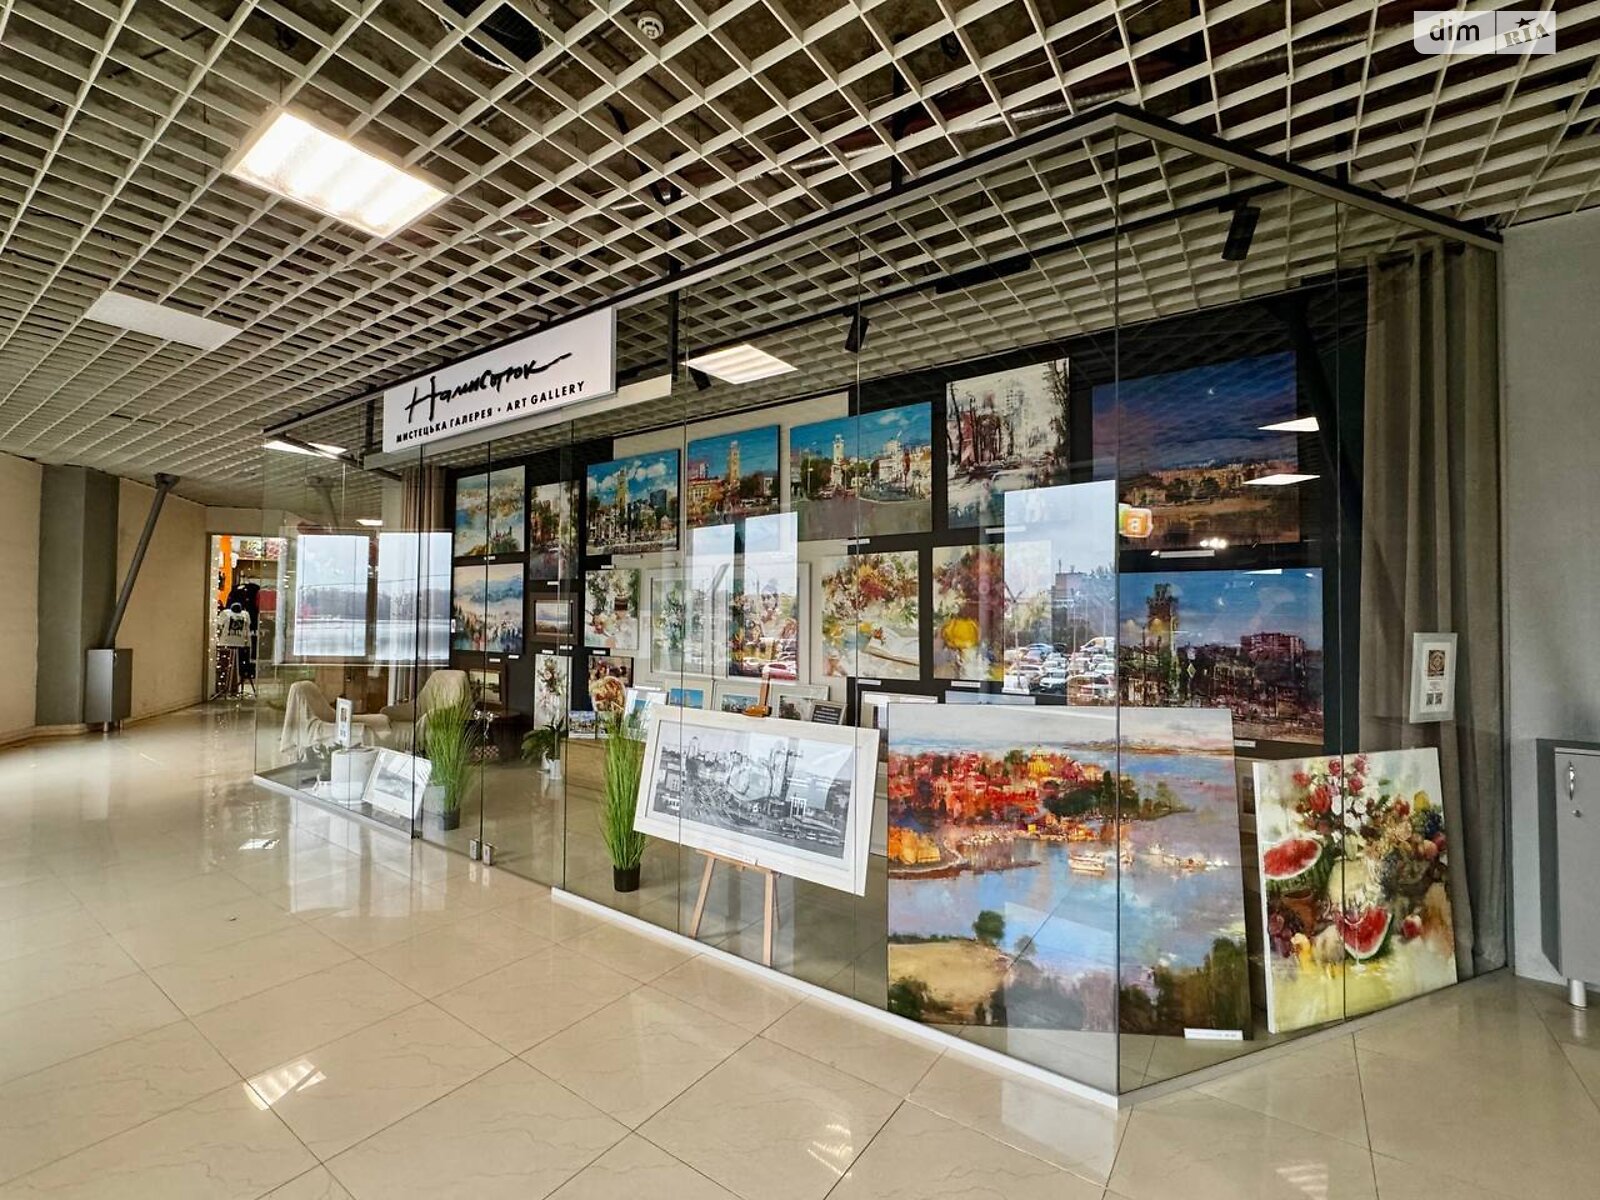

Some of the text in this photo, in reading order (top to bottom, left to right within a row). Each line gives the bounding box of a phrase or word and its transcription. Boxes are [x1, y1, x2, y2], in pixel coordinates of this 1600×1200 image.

[396, 380, 585, 443] МИСТЕЦЬКА ГАЛЕРЕЯ ART GALLERY
